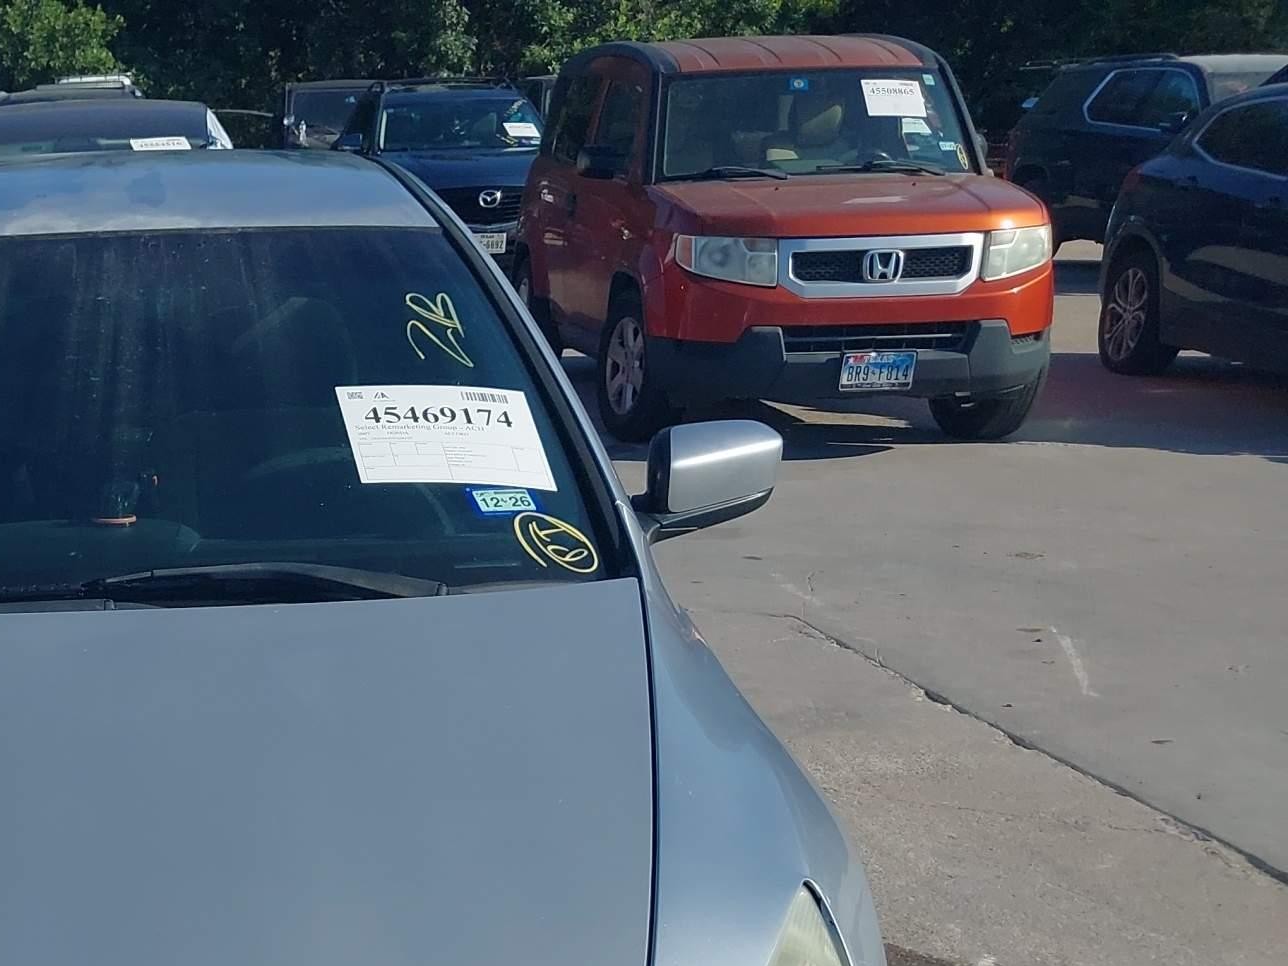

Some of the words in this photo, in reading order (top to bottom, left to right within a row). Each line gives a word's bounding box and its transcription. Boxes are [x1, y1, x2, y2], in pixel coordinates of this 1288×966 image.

[364, 405, 513, 428] 45469174
[355, 423, 380, 431] Select
[381, 423, 432, 432] Remarketing
